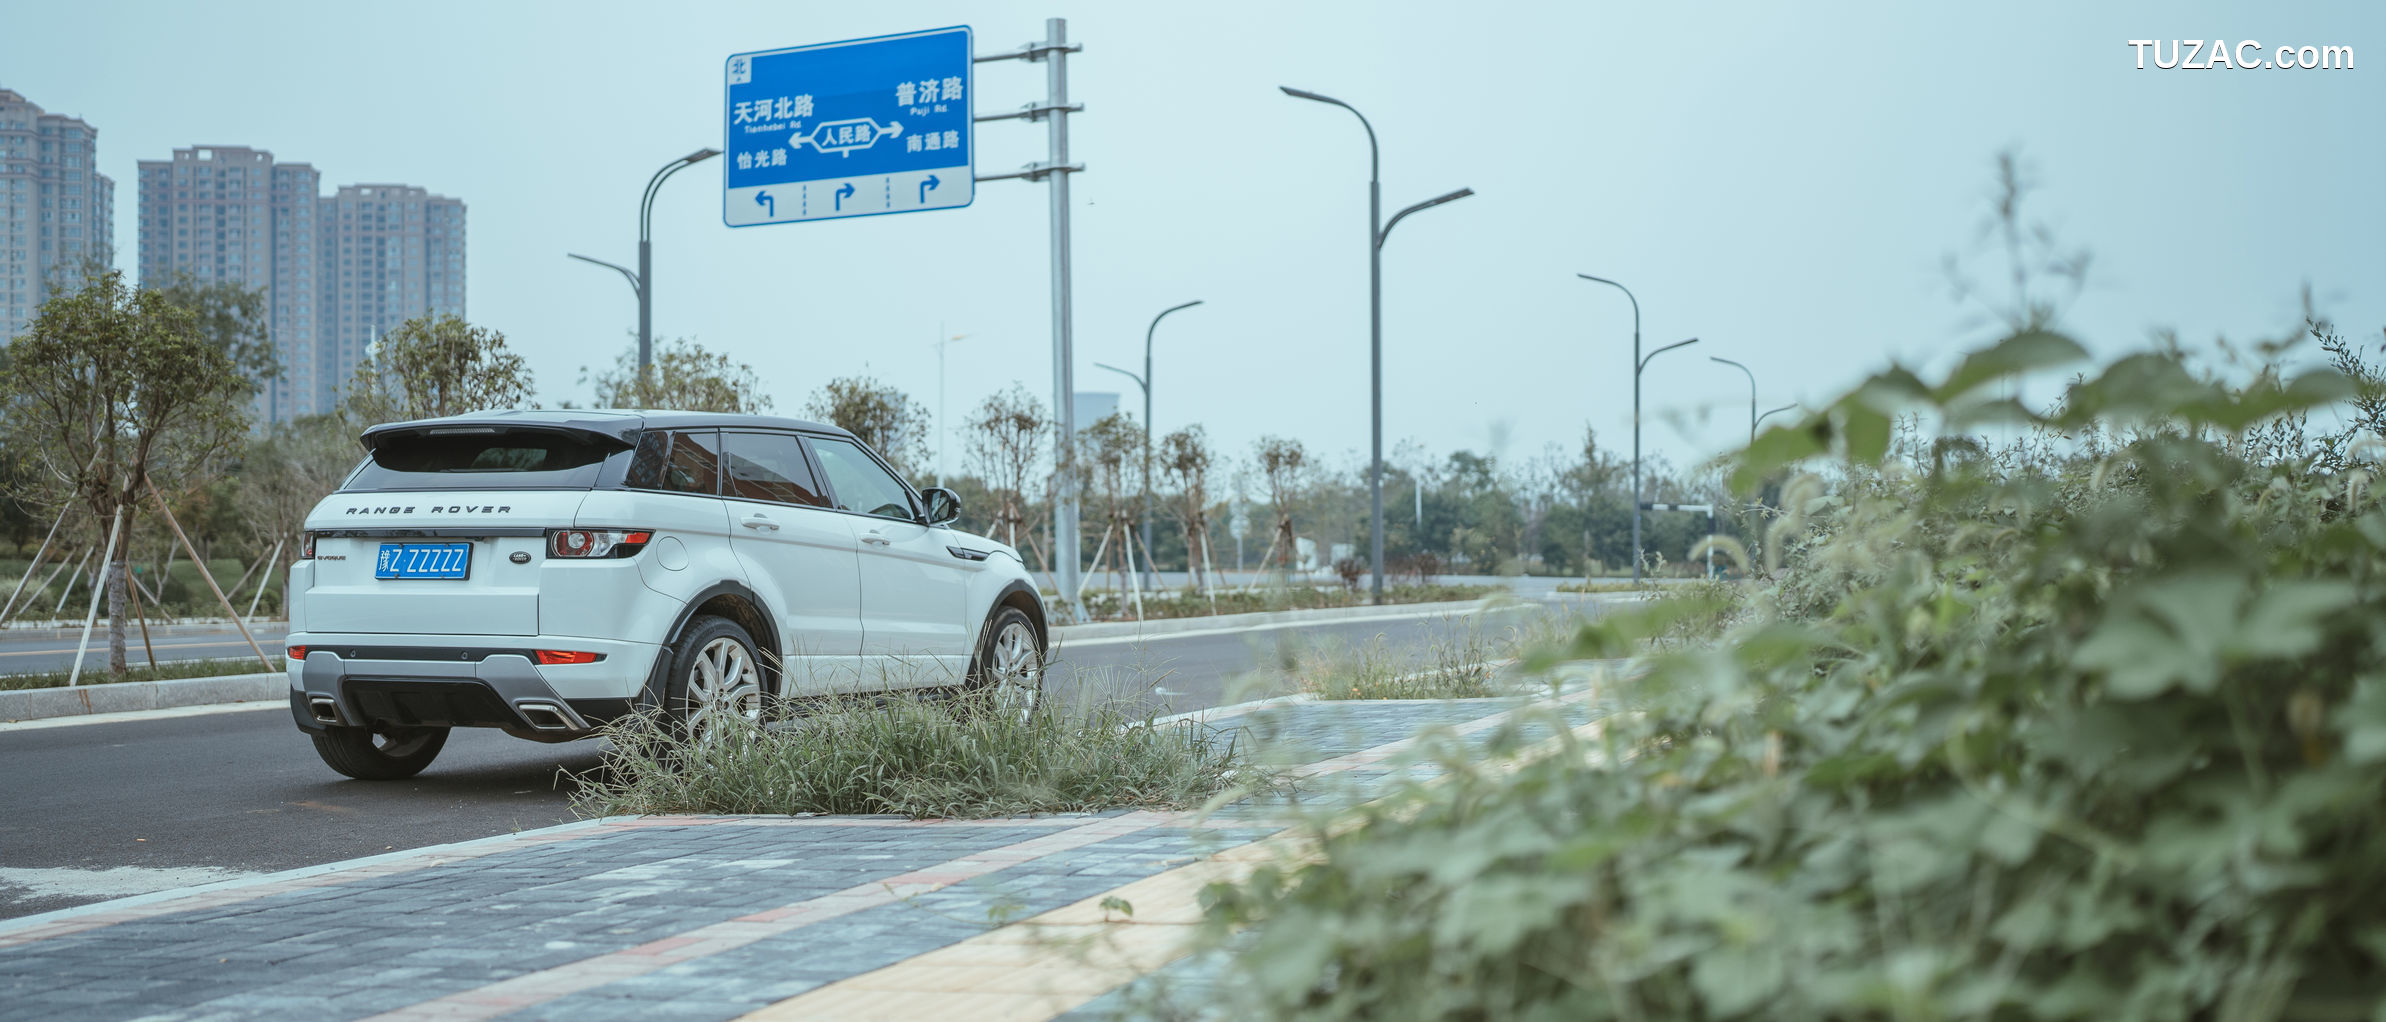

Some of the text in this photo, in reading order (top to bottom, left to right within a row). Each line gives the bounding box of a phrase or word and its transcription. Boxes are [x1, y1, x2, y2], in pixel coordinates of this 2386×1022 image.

[733, 60, 746, 74] 北
[896, 76, 963, 107] 普济路
[734, 94, 814, 125] 天河北路
[910, 106, 930, 117] Puji
[822, 124, 871, 146] 人民路
[907, 130, 959, 153] 南通路
[737, 148, 787, 170] 怡光路
[346, 505, 511, 515] RANGE ROVER
